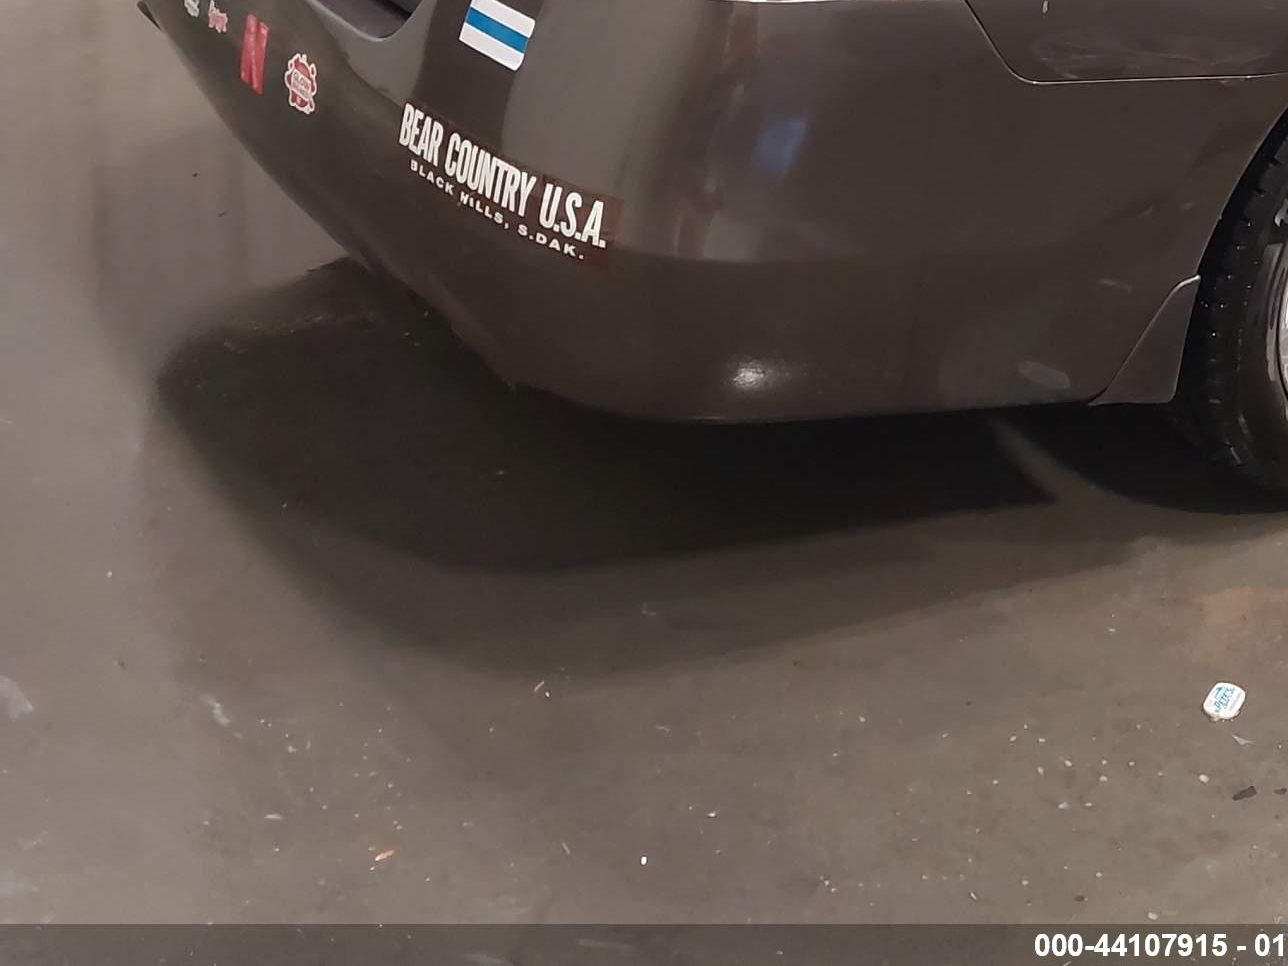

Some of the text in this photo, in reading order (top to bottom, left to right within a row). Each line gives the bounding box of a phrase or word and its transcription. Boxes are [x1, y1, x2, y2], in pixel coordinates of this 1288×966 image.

[399, 103, 607, 248] BEAR COUNTRY U.S.A.
[410, 159, 584, 260] BLACK HILLS, S.DAK.
